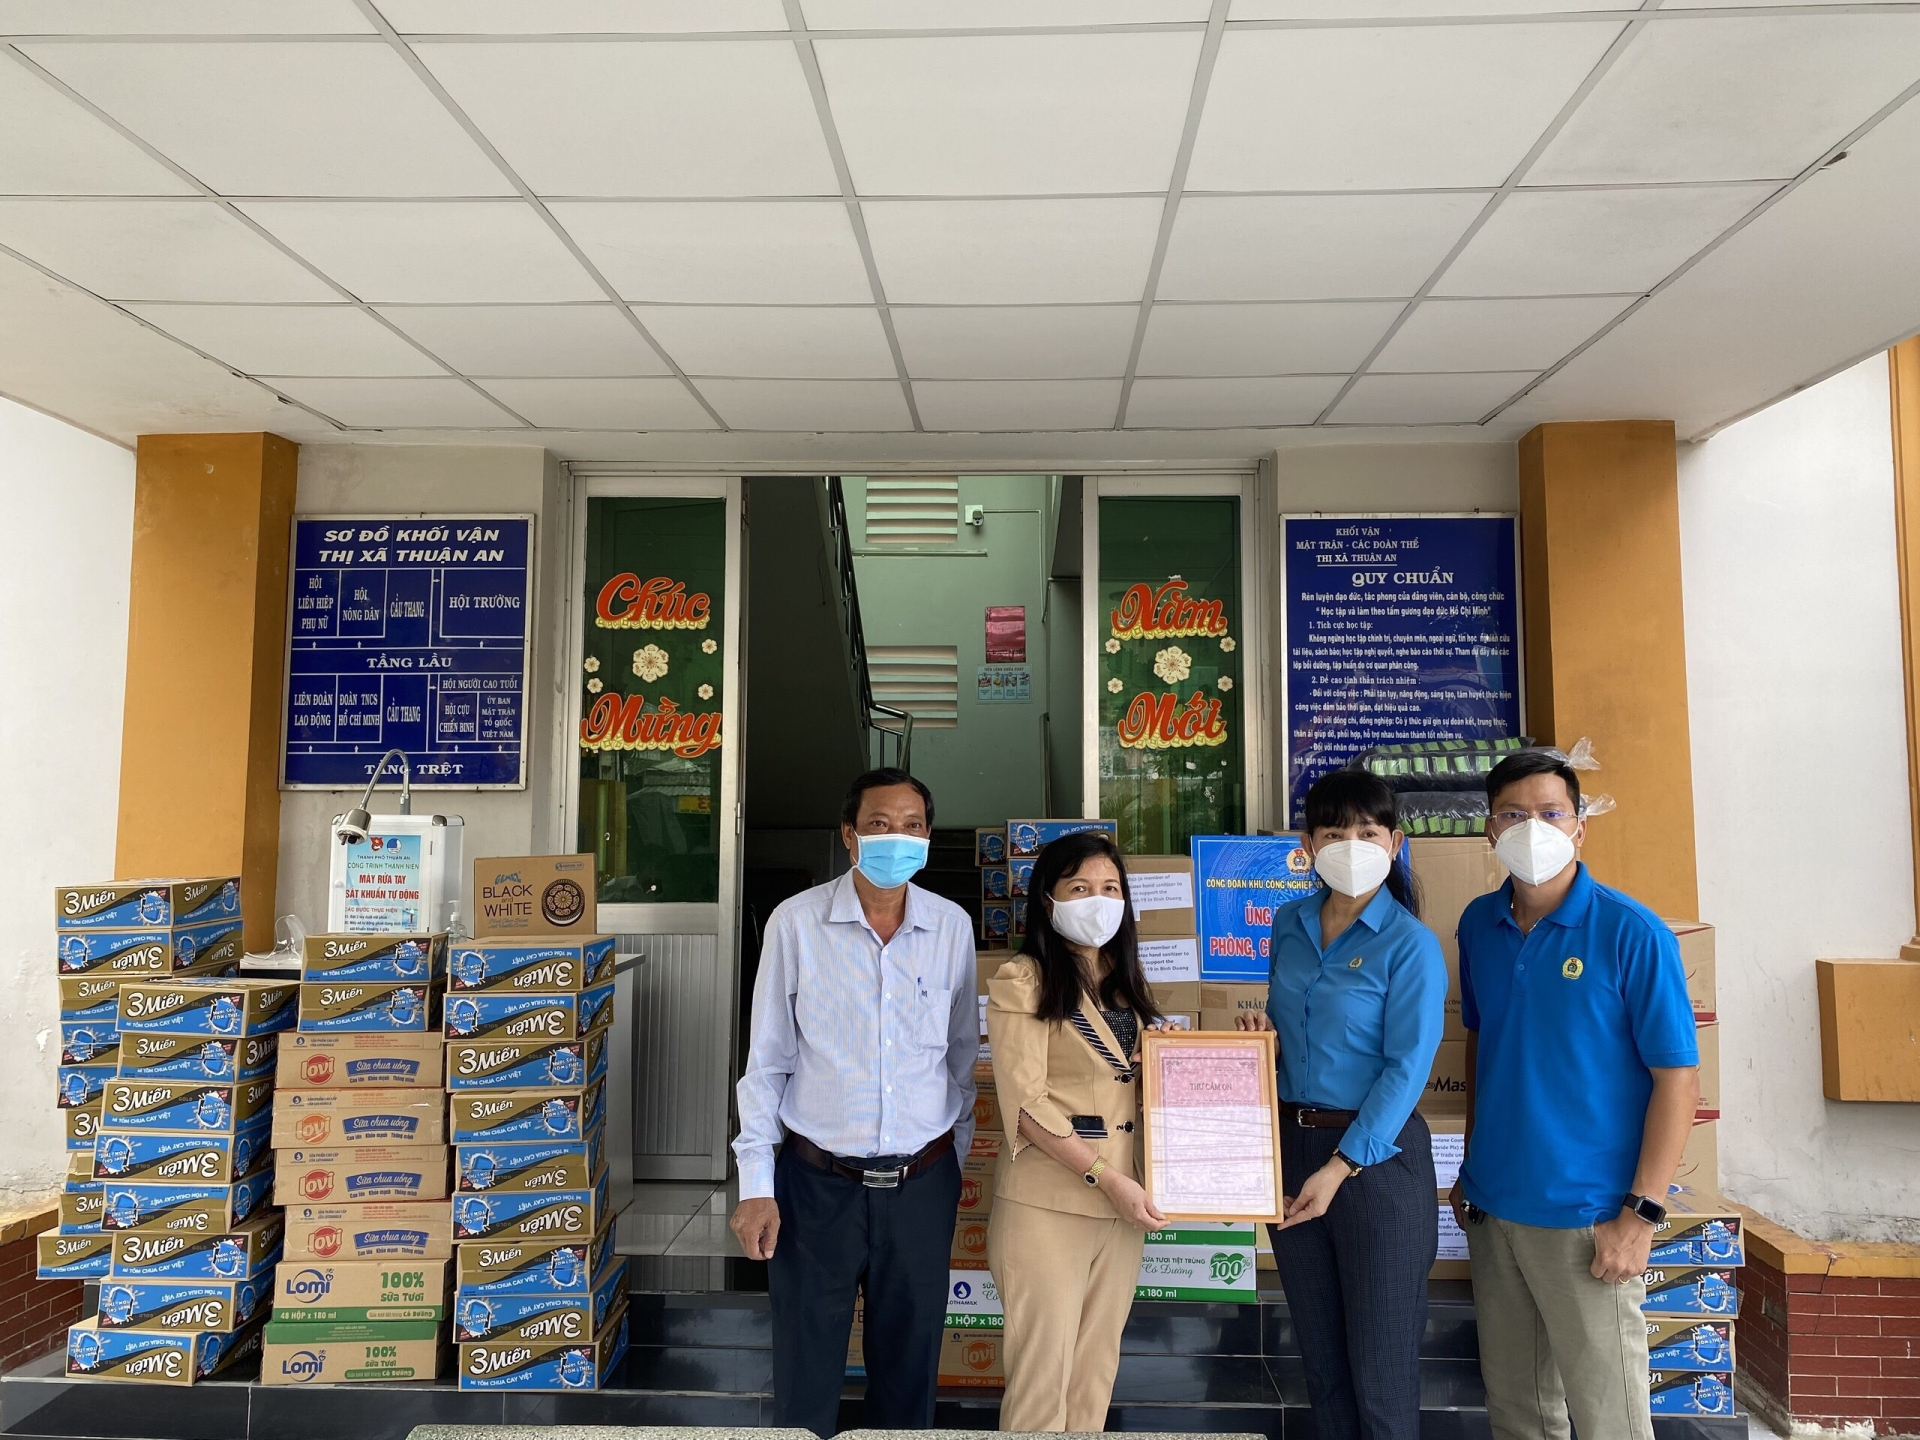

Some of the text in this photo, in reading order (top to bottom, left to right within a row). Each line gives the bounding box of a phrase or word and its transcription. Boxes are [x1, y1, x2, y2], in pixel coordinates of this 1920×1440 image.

[324, 526, 499, 543] SƠ ĐỒ KHỐI VẬN
[1336, 525, 1380, 536] KHỐI VẬN
[1296, 540, 1316, 550] MẶT
[1319, 540, 1343, 550] TRẬN
[1352, 539, 1370, 549] CÁC
[1373, 539, 1398, 548] ĐOÀN
[319, 547, 504, 564] THỊ XÃ THUẬN AN
[1316, 555, 1332, 564] THỊ
[1335, 553, 1348, 562] XÃ
[1351, 553, 1382, 562] THUẬN
[309, 575, 322, 591] HỘI
[1352, 566, 1454, 587] QUY CHUẨN
[354, 587, 368, 602] HỘI
[596, 572, 710, 622] Chúc
[1316, 593, 1334, 603] luyện
[1335, 593, 1348, 603] đạo
[1376, 593, 1397, 602] phong
[298, 595, 334, 611] LIÊN HIỆP
[404, 601, 425, 618] THANG
[449, 595, 520, 611] HỘI TRƯỜNG
[1111, 580, 1228, 633] Năm
[343, 606, 380, 621] NÔNG DÂN
[302, 615, 329, 631] PHỤ NỮ
[367, 652, 452, 668] TẦNG LẦU
[443, 678, 456, 690] HỘI
[458, 678, 481, 689] NGƯỜI
[483, 680, 498, 688] CAO
[294, 691, 333, 705] LIÊN ĐOÀN
[339, 691, 378, 705] ĐOÀN TNCS
[402, 705, 420, 723] THANG
[445, 703, 456, 716] HỘI
[294, 712, 331, 728] LAO ĐỘNG
[338, 709, 380, 726] HỒ CHÍ MINH
[440, 718, 474, 732] CHIẾN BINH
[580, 692, 723, 758] Mừng
[1118, 691, 1227, 744] Mới
[416, 762, 464, 776] TRỆT
[359, 873, 375, 883] MÁY
[395, 875, 406, 884] TAY
[1249, 879, 1264, 888] KHU
[399, 889, 419, 901] ĐỘNG
[483, 884, 532, 898] BLACK
[484, 902, 532, 917] WHITE
[286, 1273, 331, 1295] Lomi
[381, 1272, 424, 1288] 100%
[280, 1311, 290, 1319] 48
[291, 1311, 306, 1322] HỘP
[314, 1311, 326, 1319] 180
[328, 1311, 336, 1319] ml
[955, 1314, 977, 1328] HỘP
[988, 1317, 1003, 1326] 180
[365, 1346, 396, 1358] 100%
[282, 1356, 323, 1374] Lomi
